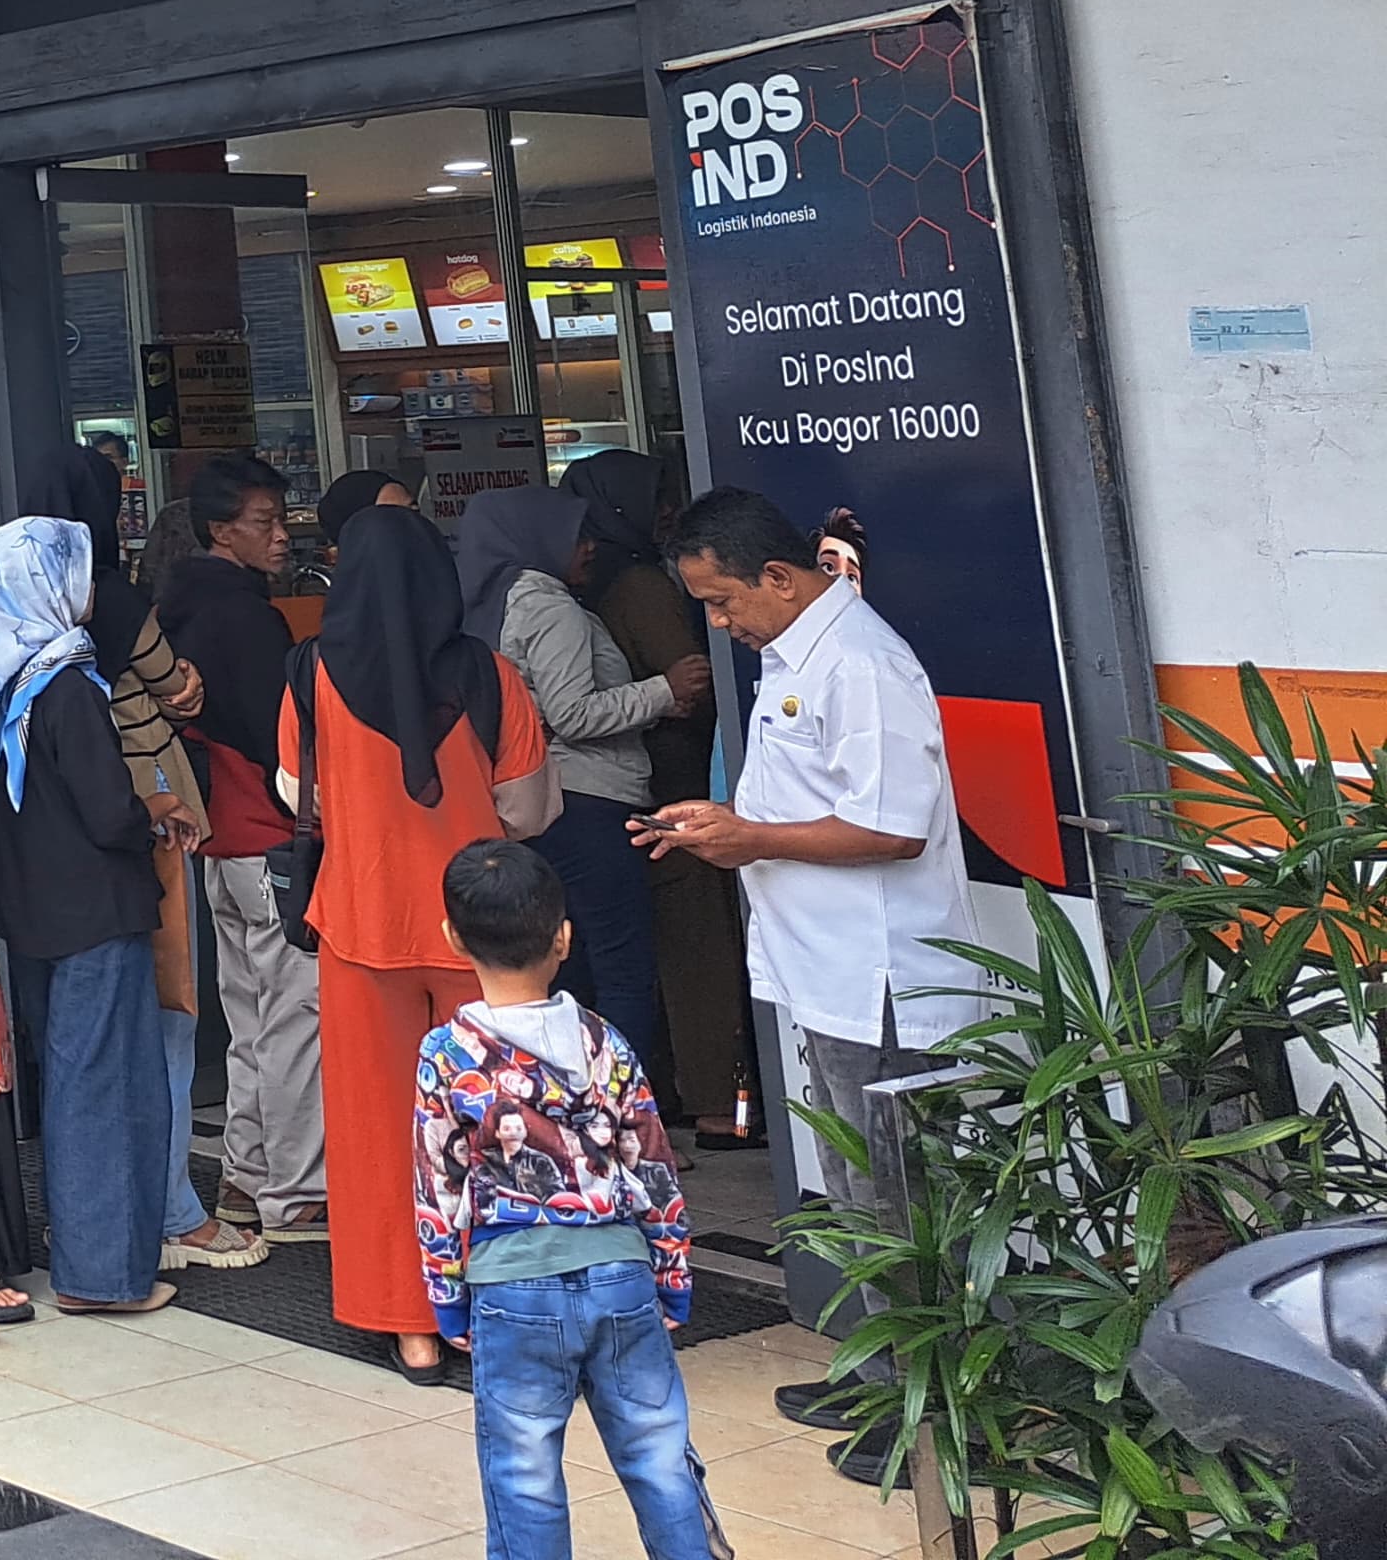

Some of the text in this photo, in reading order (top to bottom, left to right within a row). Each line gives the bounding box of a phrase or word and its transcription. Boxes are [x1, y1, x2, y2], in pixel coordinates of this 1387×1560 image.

[682, 74, 804, 149] POS
[697, 205, 817, 238] Logistik Indonesia
[446, 254, 479, 265] hotdog
[725, 288, 966, 335] Selamat Datang
[781, 345, 915, 387] Di PosInd
[738, 403, 980, 453] Kcu Bogor 16000
[438, 471, 485, 496] SELAMAT
